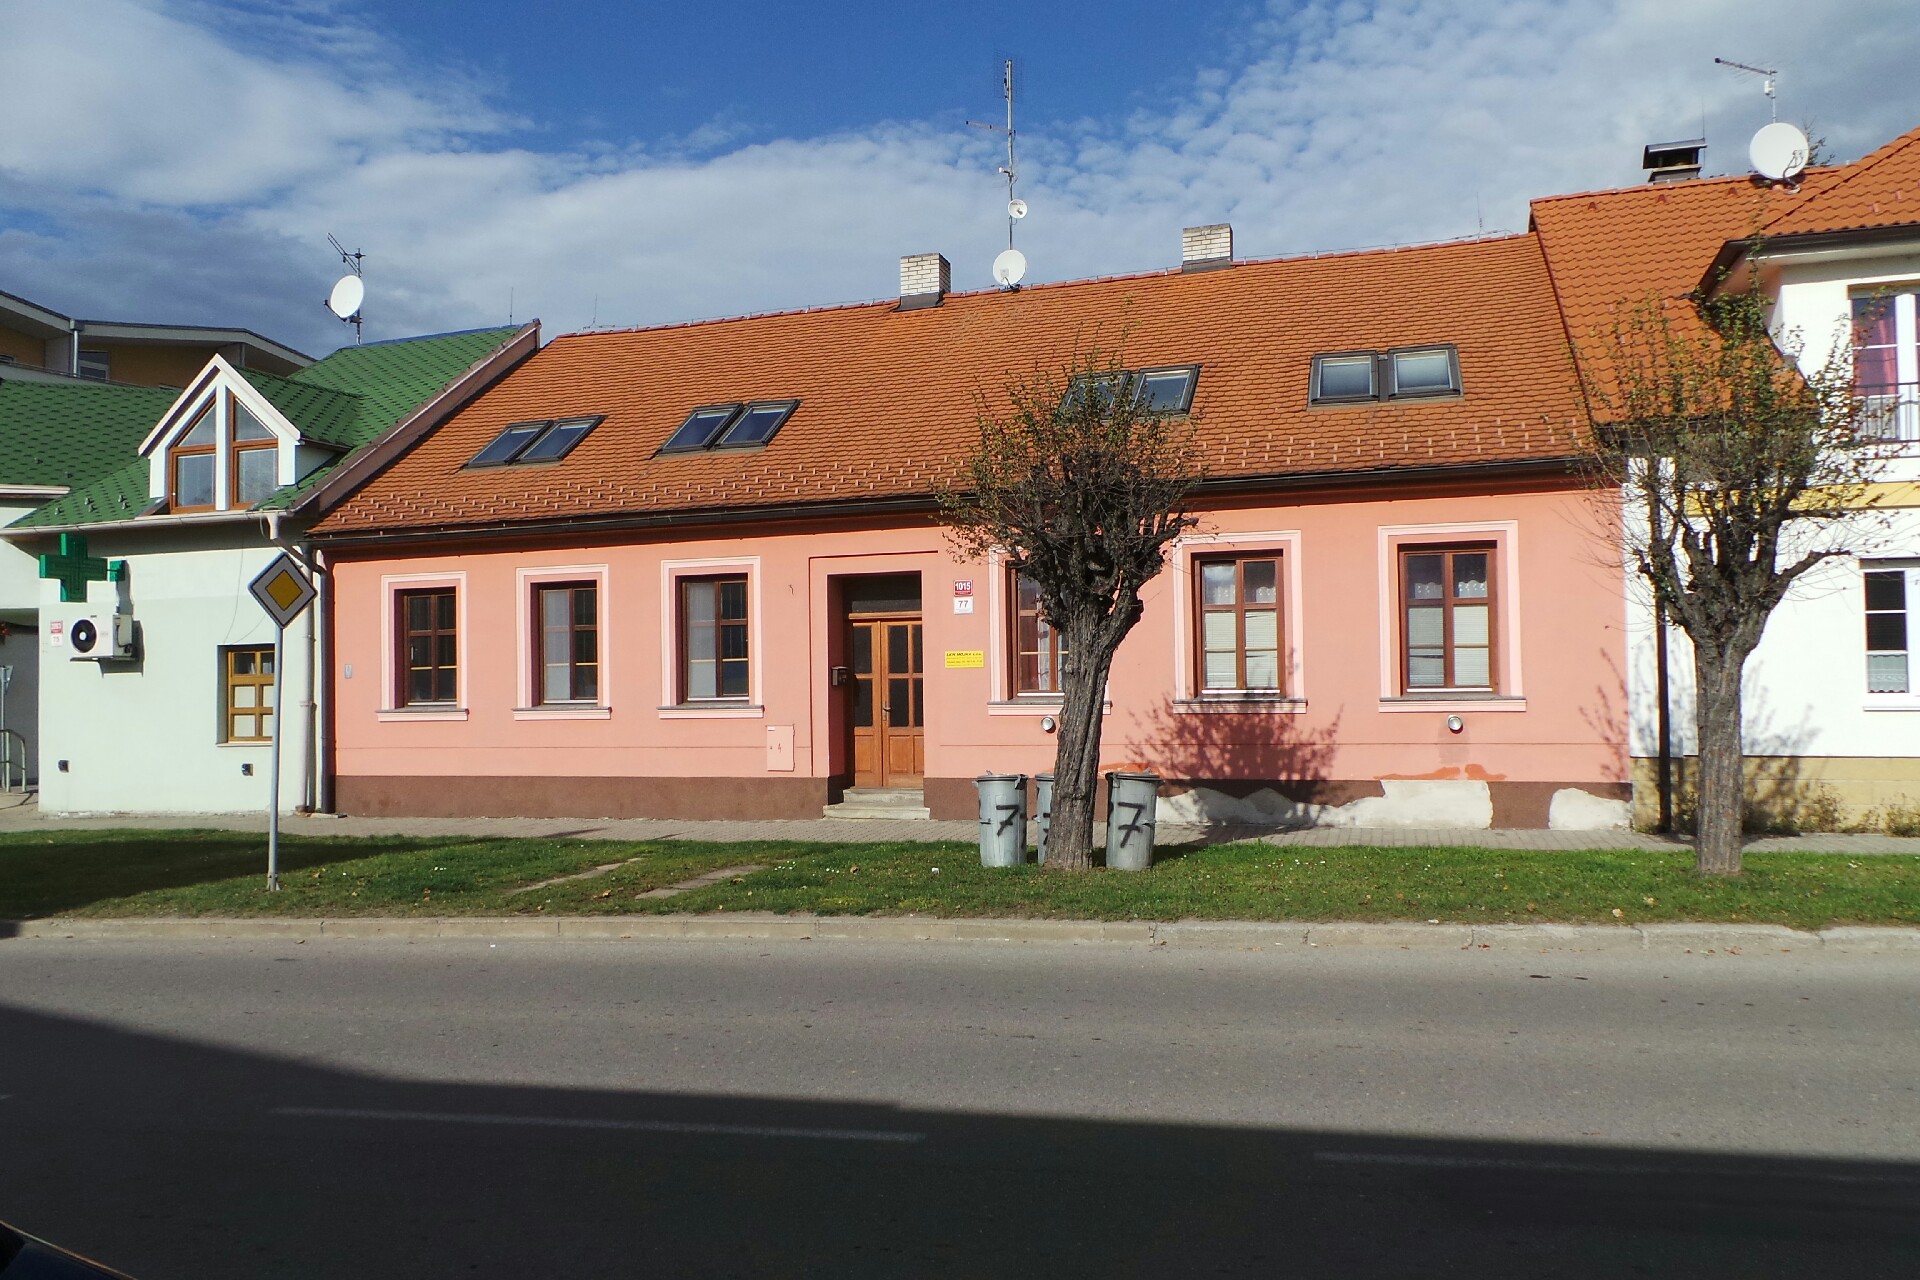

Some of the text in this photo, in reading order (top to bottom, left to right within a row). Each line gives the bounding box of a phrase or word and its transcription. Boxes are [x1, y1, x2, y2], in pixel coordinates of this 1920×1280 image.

[956, 582, 970, 590] 1015
[958, 600, 968, 608] 77
[996, 804, 1019, 837] 7
[1117, 801, 1146, 848] 7
